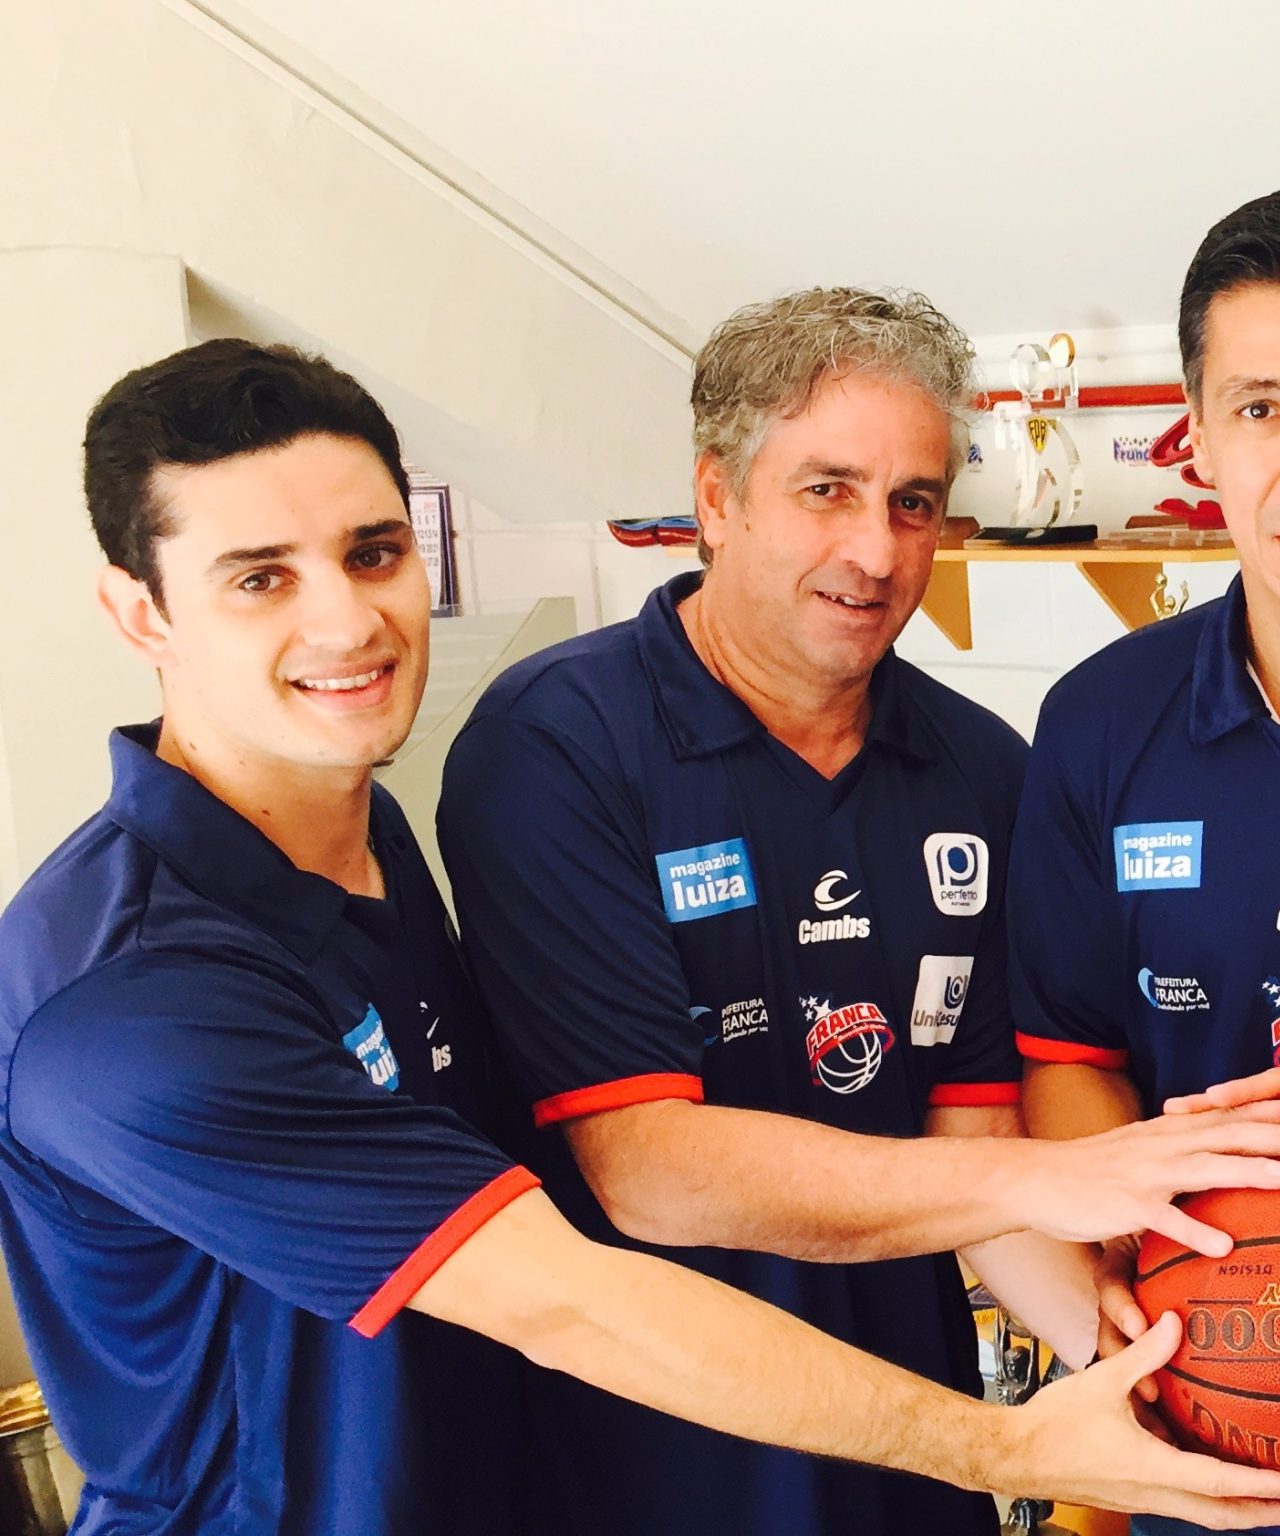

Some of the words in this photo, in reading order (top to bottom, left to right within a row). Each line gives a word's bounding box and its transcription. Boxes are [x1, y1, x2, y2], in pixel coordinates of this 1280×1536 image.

[669, 853, 741, 878] magazine
[1124, 851, 1192, 880] luiza
[672, 875, 747, 910] luiza
[799, 915, 870, 945] Cambs
[1155, 988, 1207, 1003] FRANCA
[807, 1004, 886, 1059] FRANCA
[1218, 1264, 1271, 1276] DESIGN
